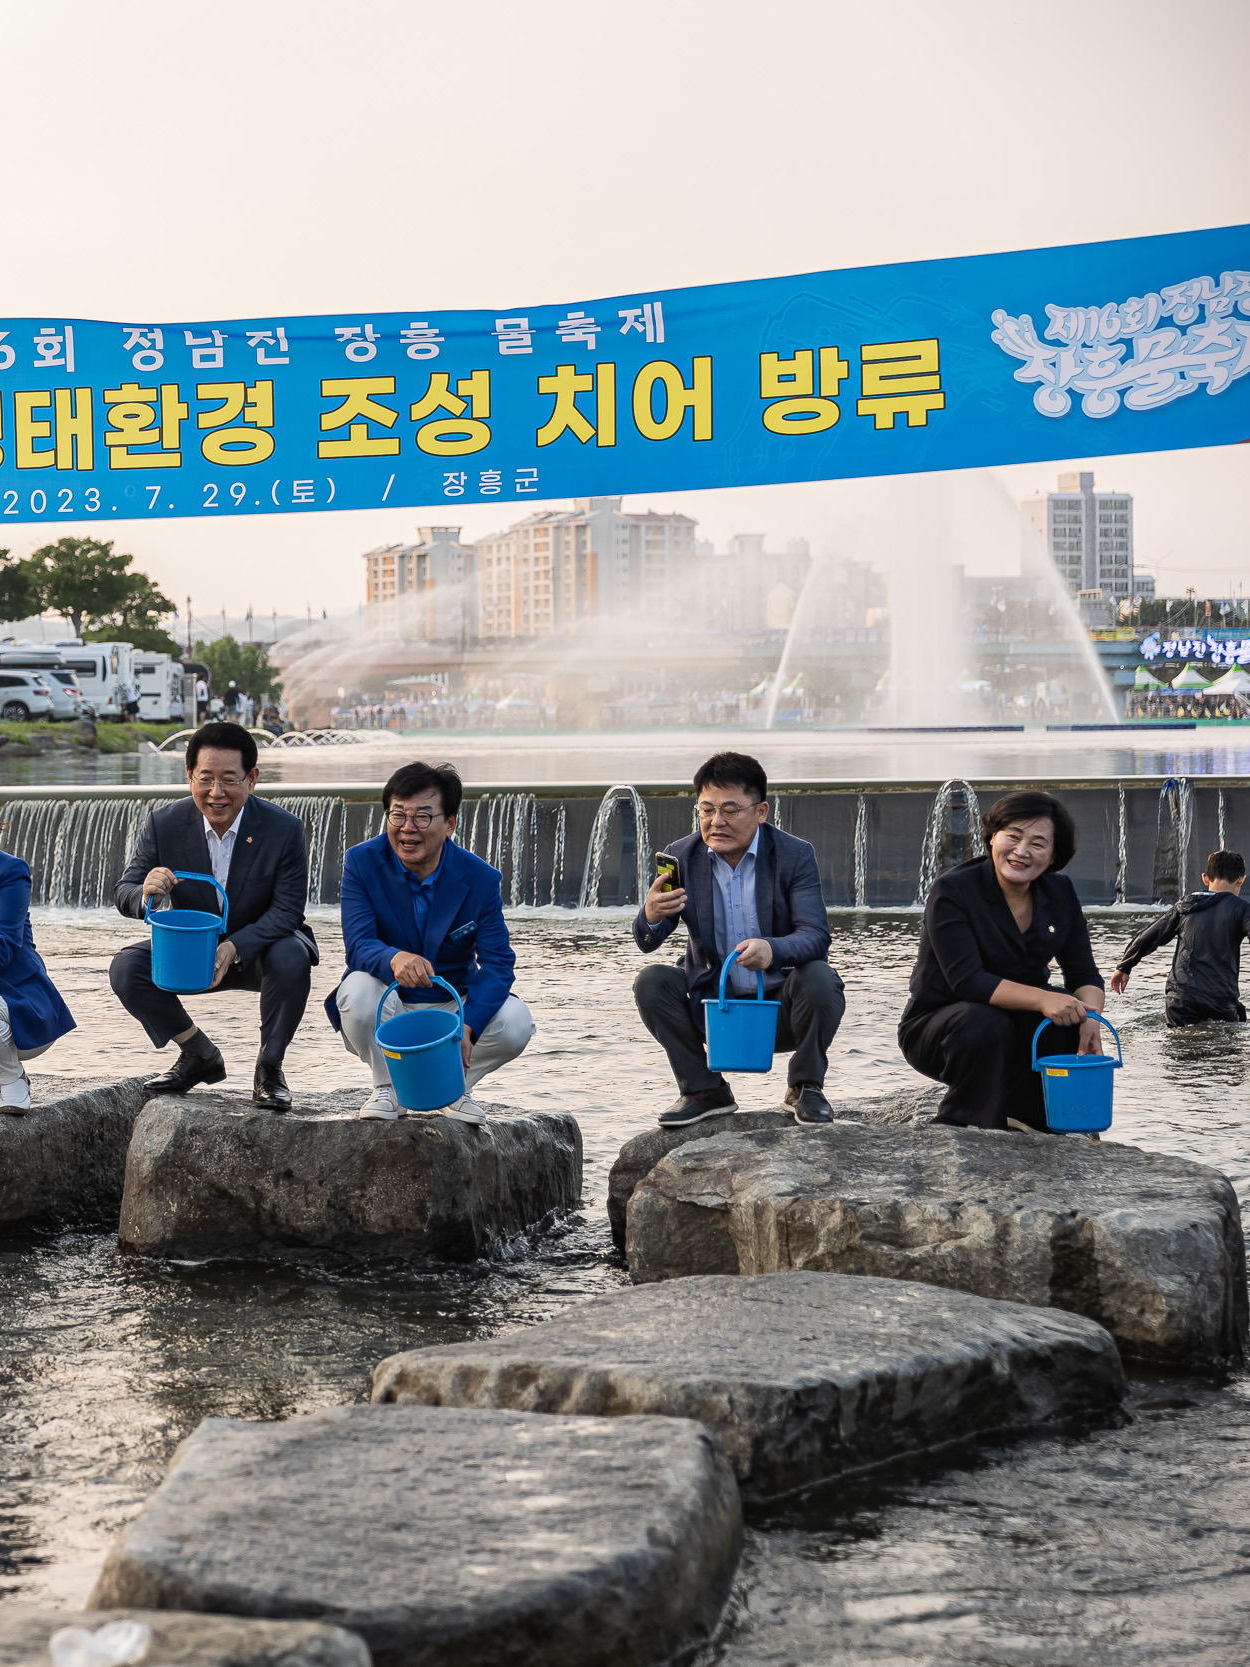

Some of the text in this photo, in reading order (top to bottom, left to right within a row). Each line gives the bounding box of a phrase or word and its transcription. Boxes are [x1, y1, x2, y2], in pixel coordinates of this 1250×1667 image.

[121, 326, 290, 372] 정남진
[334, 320, 445, 363] 장흥
[490, 302, 665, 356] 물축제
[1047, 297, 1158, 342] 제16회
[316, 369, 492, 460] 조성
[535, 355, 713, 449] 치어
[758, 337, 946, 436] 방류
[3, 487, 118, 516] 2023.
[442, 467, 539, 497] 장흥군
